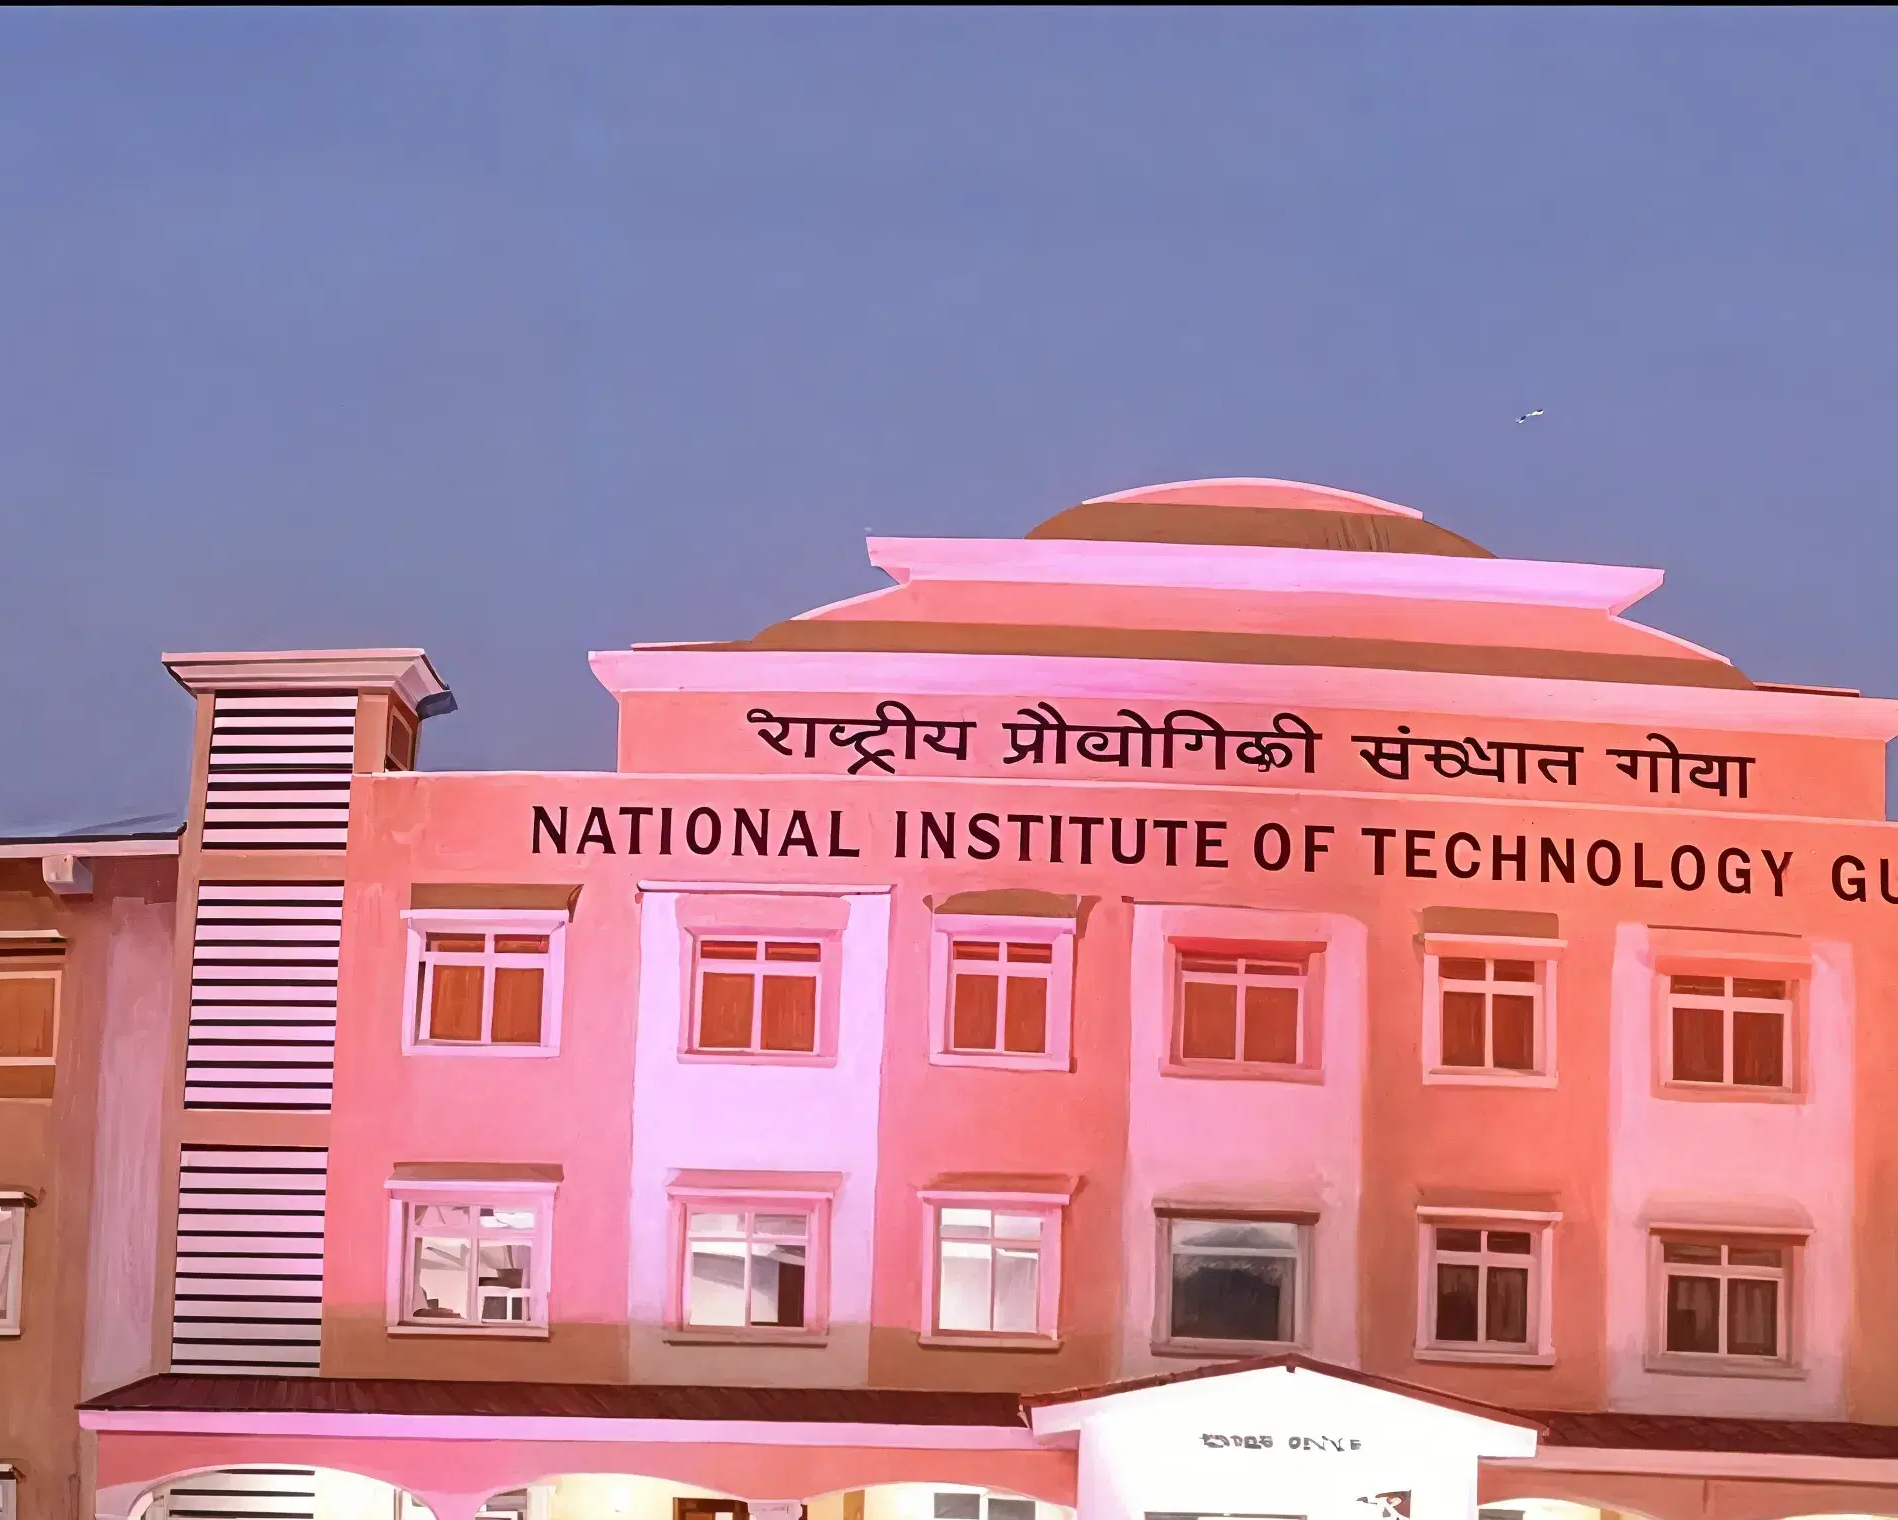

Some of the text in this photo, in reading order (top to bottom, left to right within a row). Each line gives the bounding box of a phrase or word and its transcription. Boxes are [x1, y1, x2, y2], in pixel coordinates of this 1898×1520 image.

[532, 805, 860, 858] NATIONAL
[894, 810, 1229, 868] INSTITUTE
[1253, 822, 1335, 873] OF
[1361, 827, 1794, 897] TECHNOLOGY
